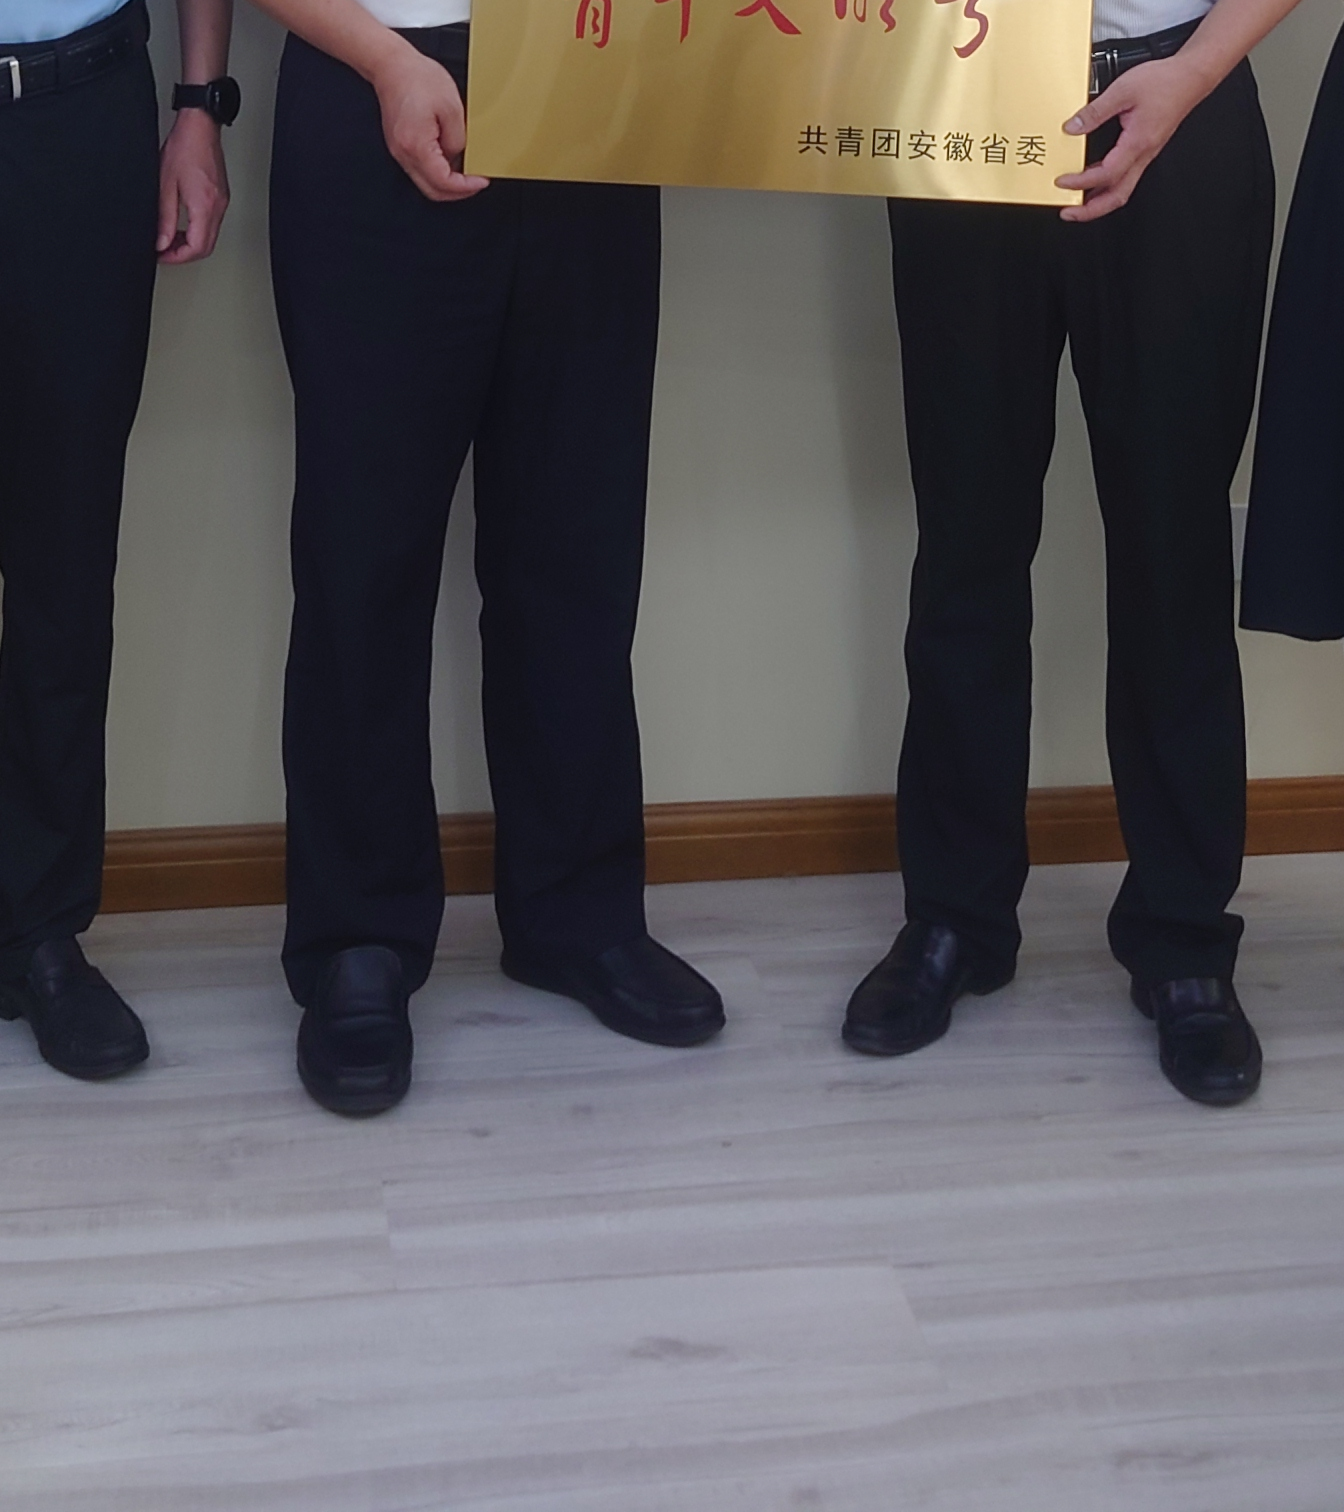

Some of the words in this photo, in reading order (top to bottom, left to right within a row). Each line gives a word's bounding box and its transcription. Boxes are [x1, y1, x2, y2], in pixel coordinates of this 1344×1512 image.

[797, 124, 1047, 167] 共青团安徽省委
